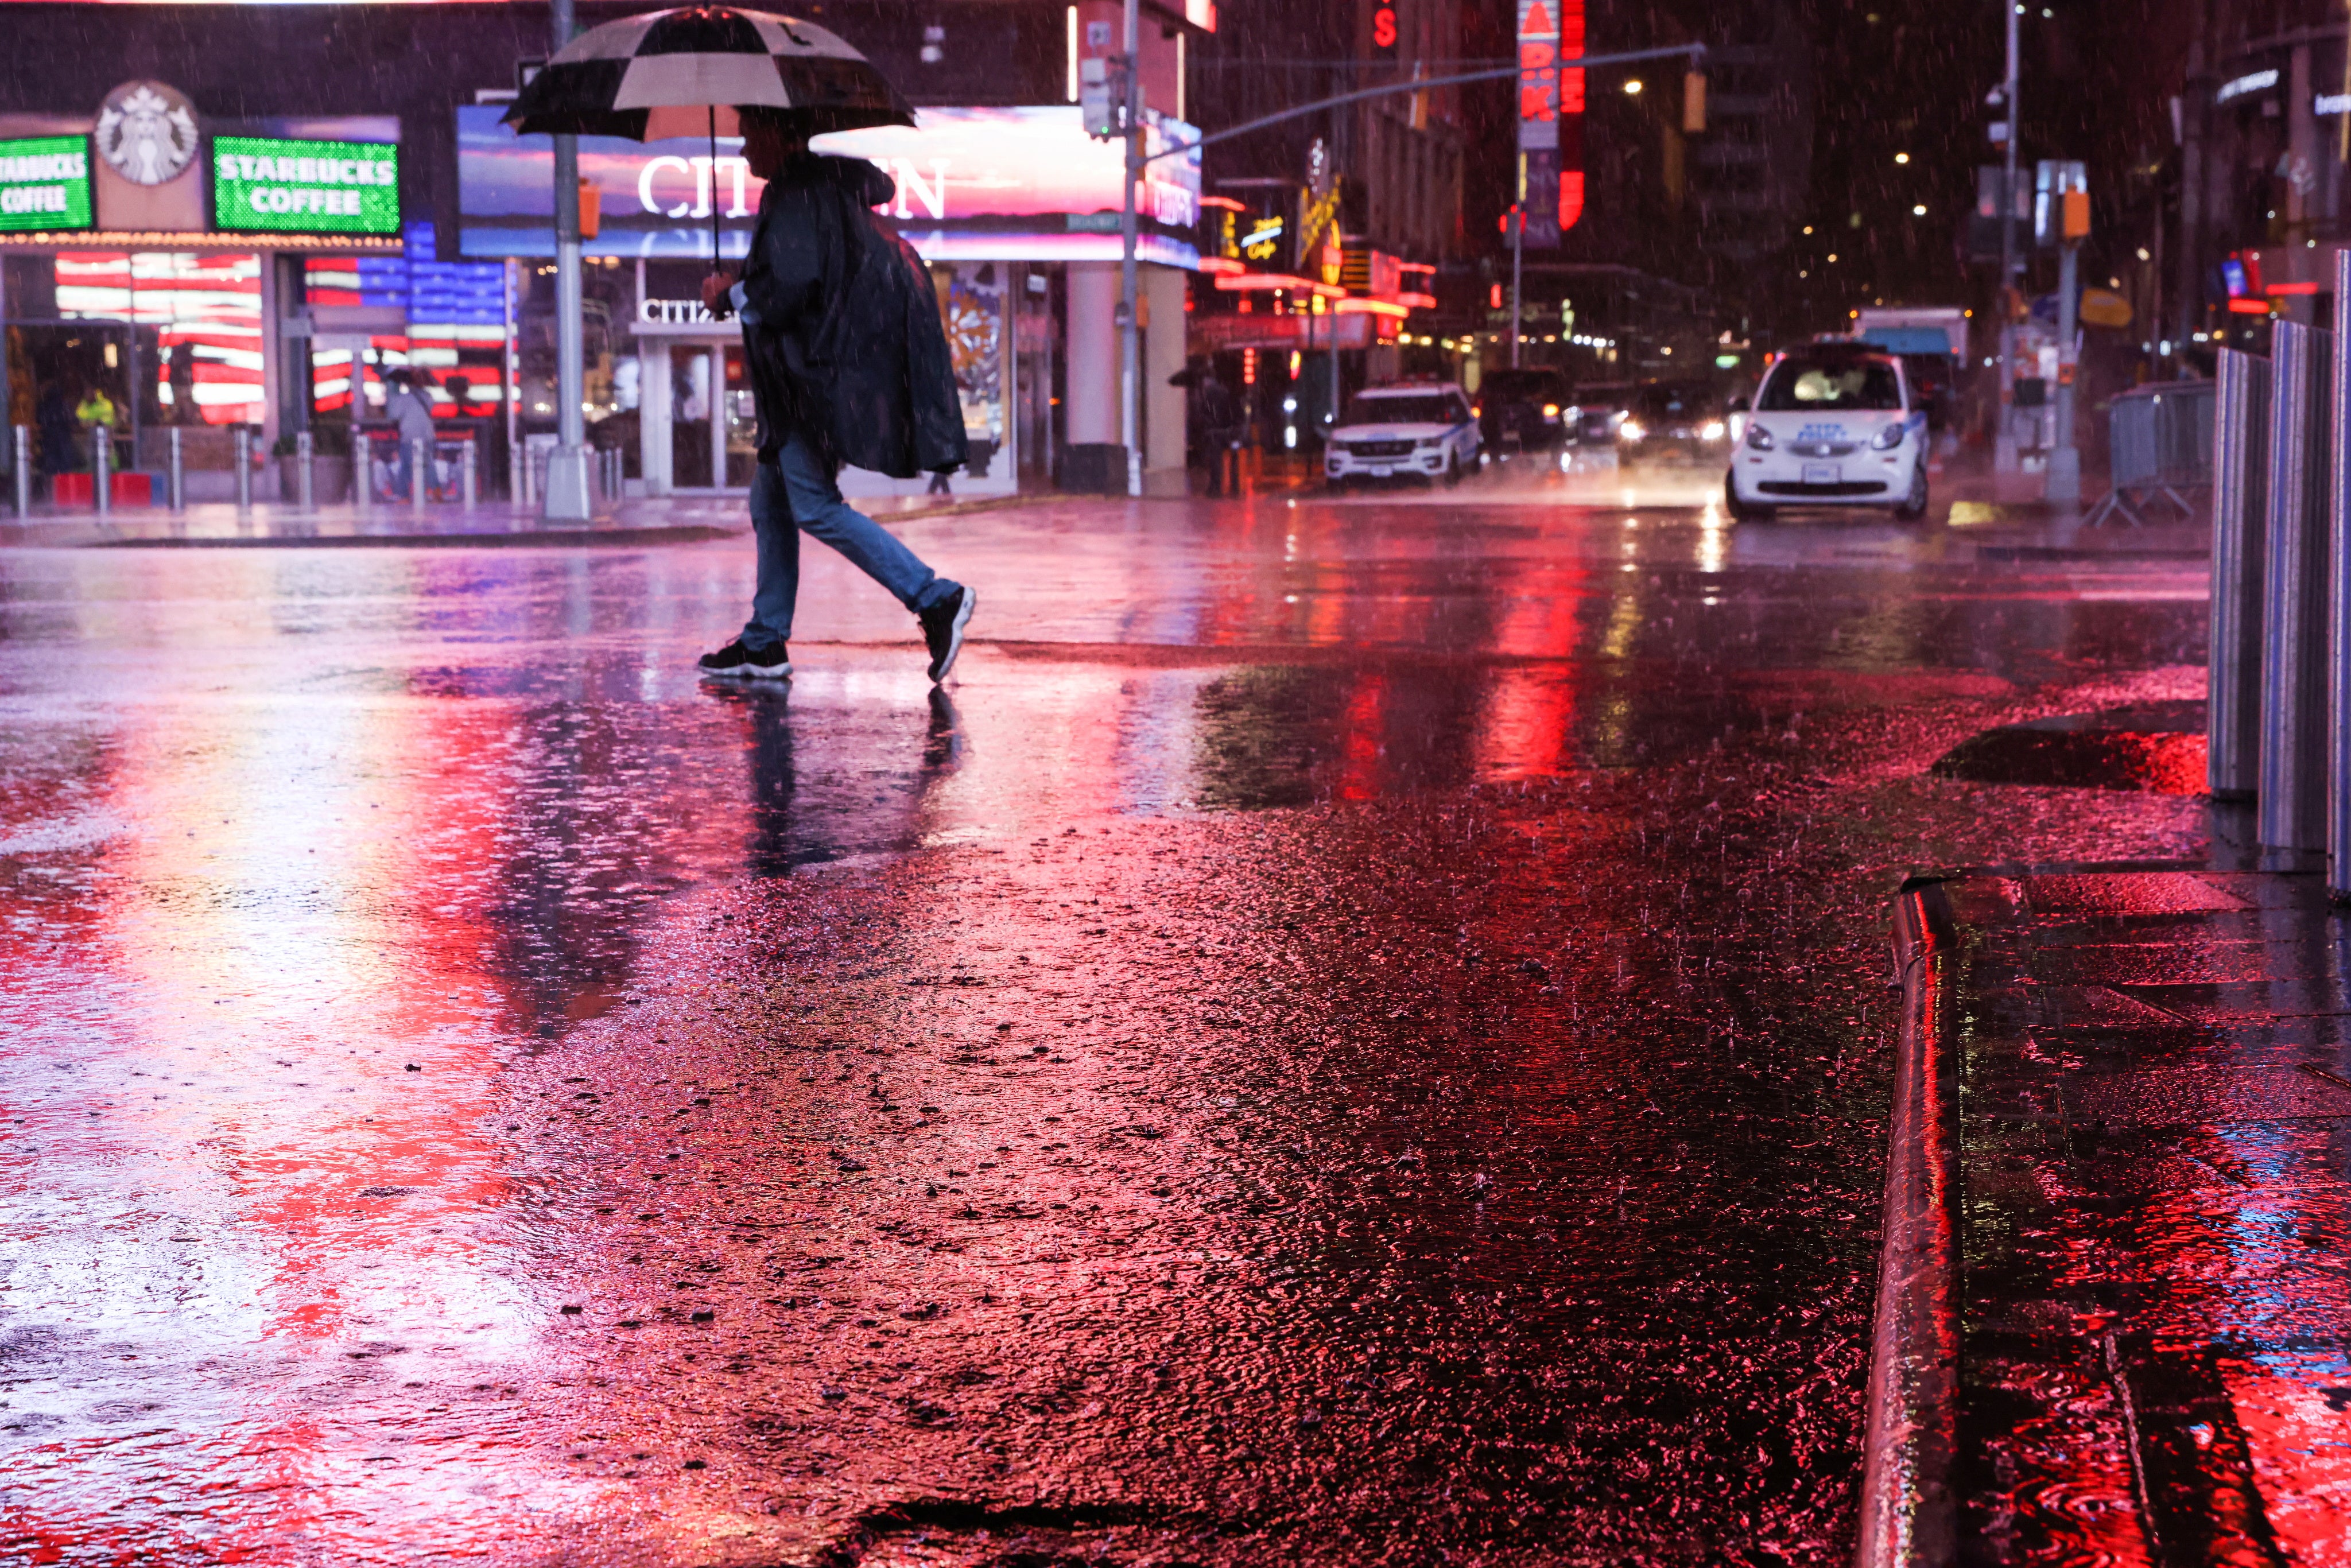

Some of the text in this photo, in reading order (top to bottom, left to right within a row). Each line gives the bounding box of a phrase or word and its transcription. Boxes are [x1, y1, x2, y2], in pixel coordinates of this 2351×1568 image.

[219, 153, 394, 186] STARBUCKS
[1, 185, 67, 214] COFFEE
[250, 187, 361, 216] COFFEE
[640, 298, 740, 324] CITIZ
